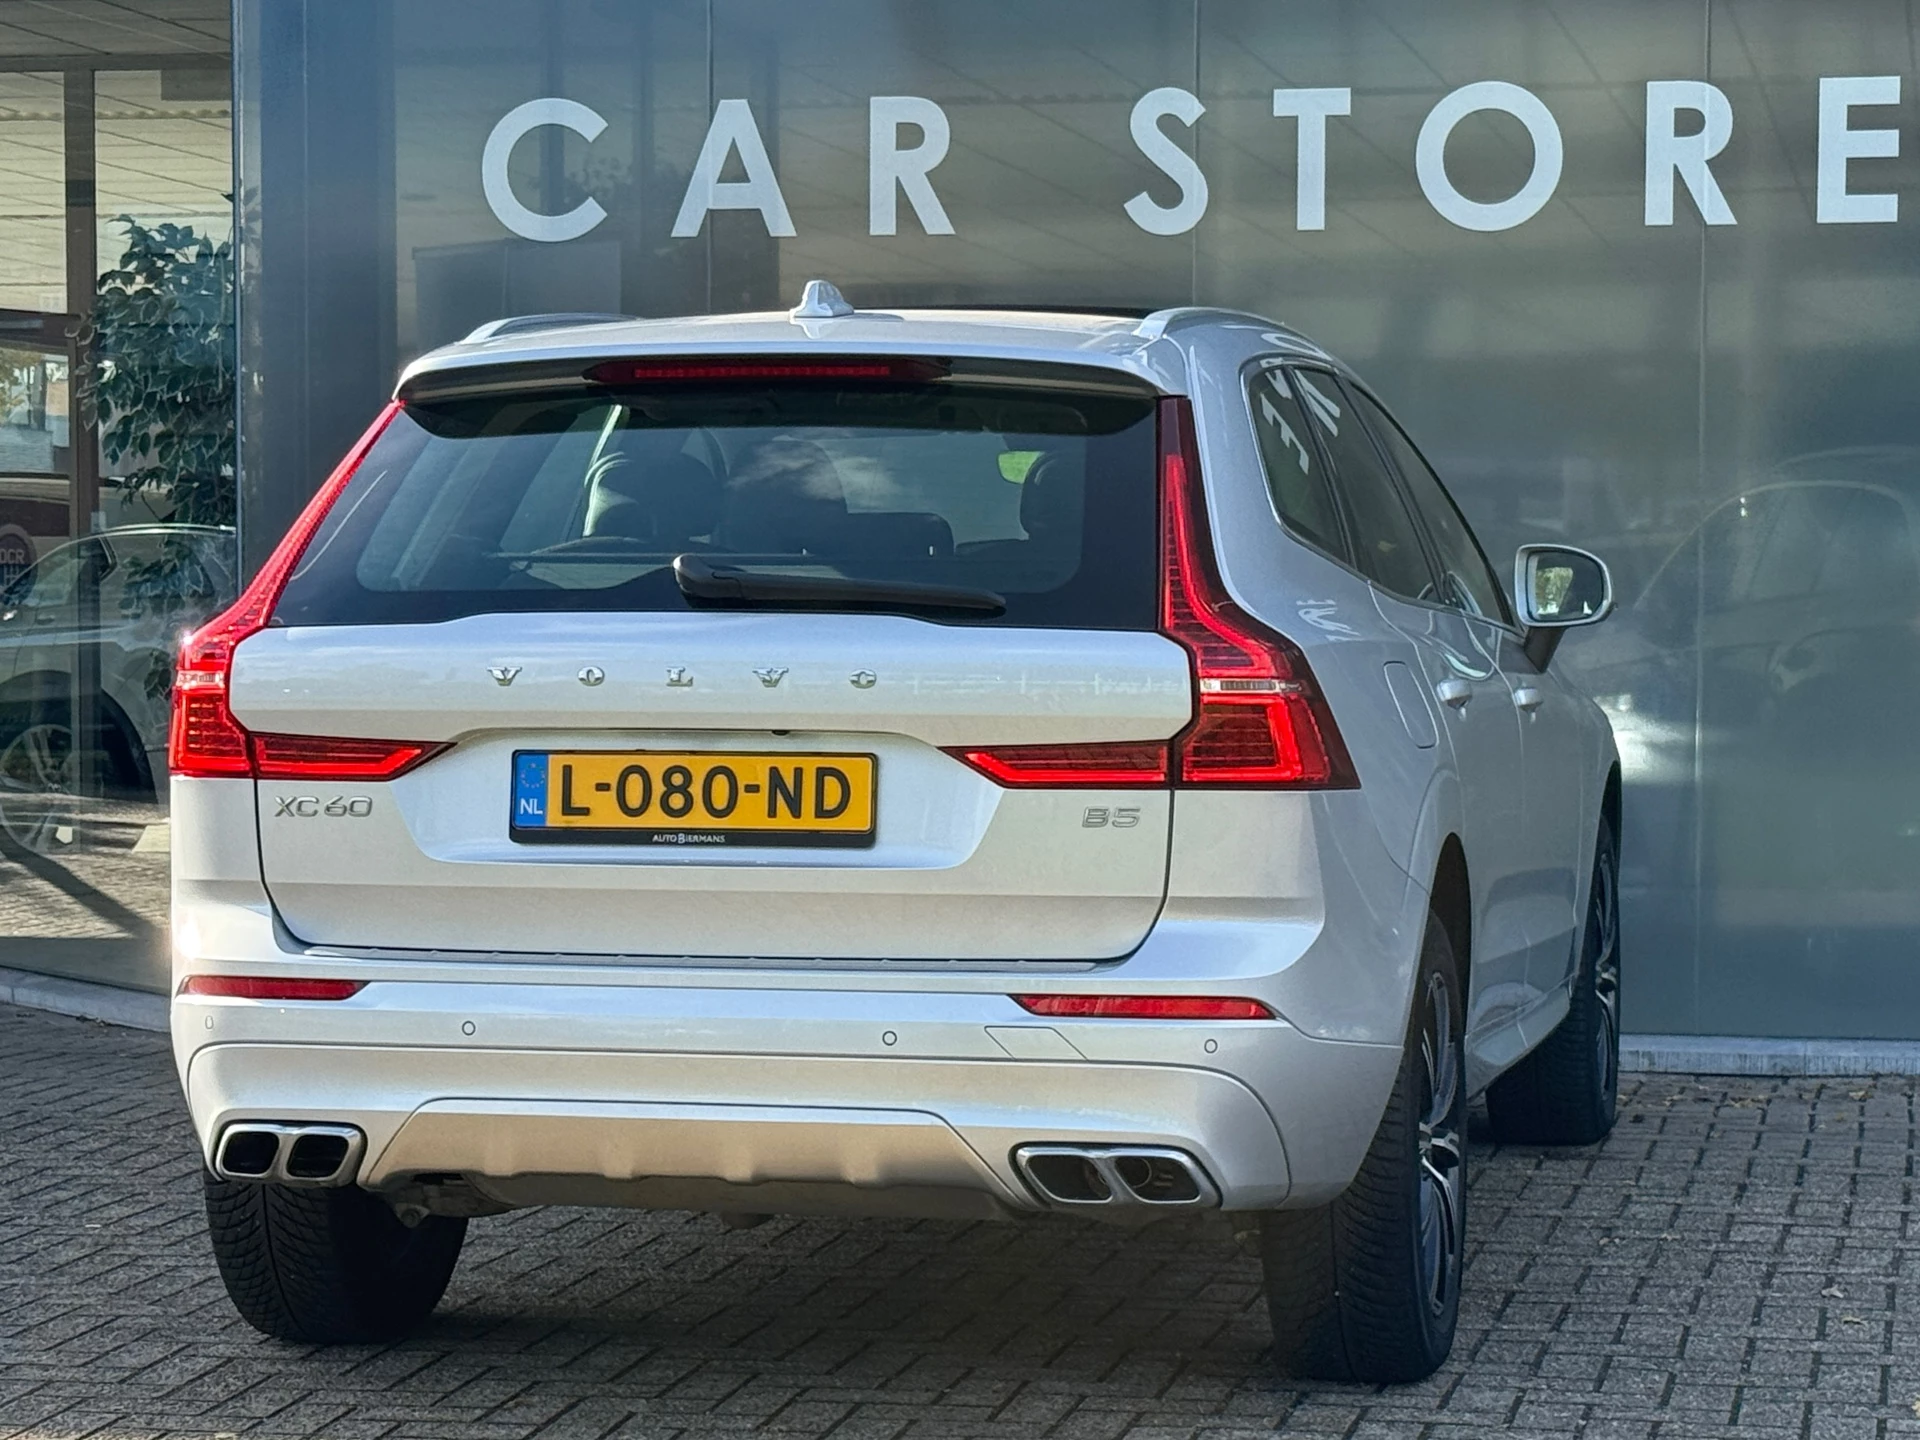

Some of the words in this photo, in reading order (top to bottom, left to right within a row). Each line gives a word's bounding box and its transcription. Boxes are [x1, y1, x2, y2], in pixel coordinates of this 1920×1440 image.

[482, 96, 956, 243] CAR
[1123, 76, 1902, 236] STORE
[486, 665, 878, 689] VOLVO
[519, 797, 544, 816] NL
[560, 763, 852, 820] L-080-ND
[274, 796, 373, 817] XC60
[1082, 806, 1141, 828] B5
